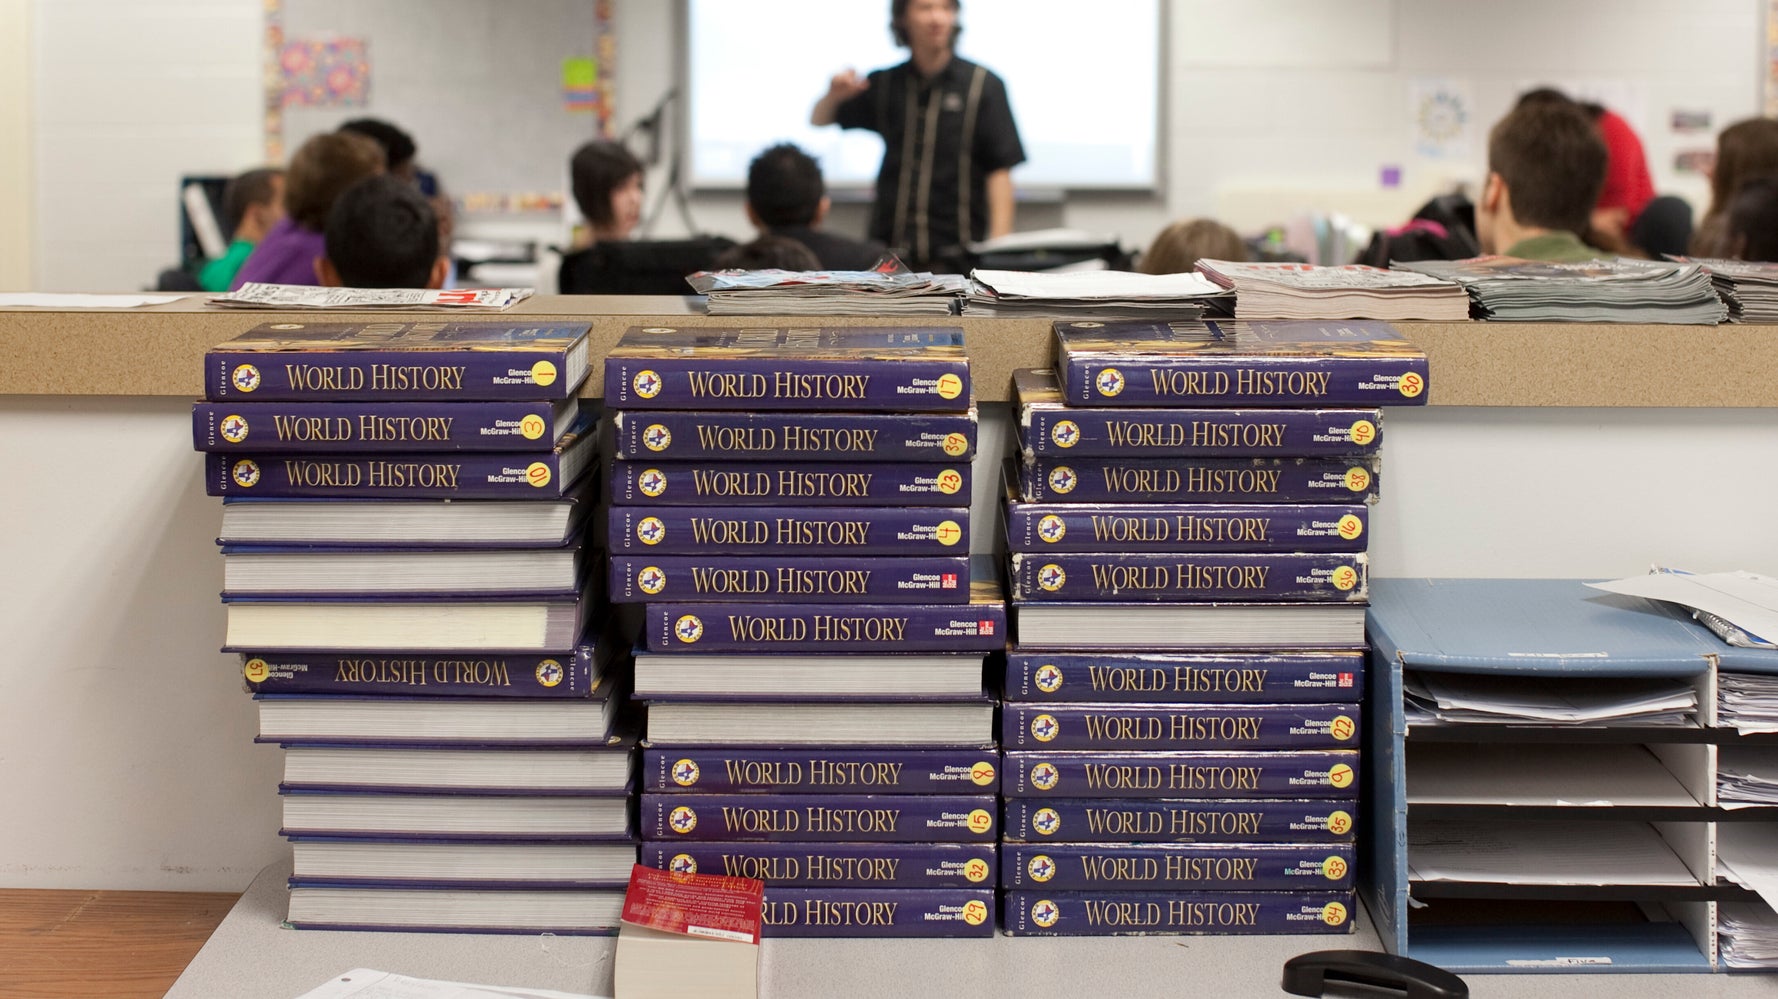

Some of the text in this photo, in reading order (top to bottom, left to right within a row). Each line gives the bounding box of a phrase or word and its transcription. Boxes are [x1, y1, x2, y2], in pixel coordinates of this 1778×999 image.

[286, 365, 363, 390] WORLD
[371, 366, 465, 390] HISTORY
[508, 369, 532, 377] Glenco
[1151, 370, 1229, 394] WORLD
[1237, 370, 1331, 394] HISTORY
[689, 373, 765, 398] WORLD
[773, 373, 870, 398] HISTORY
[940, 379, 958, 394] 17
[1401, 376, 1420, 393] 30
[274, 416, 351, 440] WORLD
[359, 417, 453, 441] HISTORY
[524, 421, 542, 434] 3
[1107, 421, 1184, 446] WORLD
[1192, 421, 1286, 447] HISTORY
[1354, 425, 1372, 443] 40
[698, 426, 775, 450] WORLD
[783, 427, 877, 451] HISTORY
[945, 435, 964, 453] 39
[286, 461, 360, 486] WORLD
[369, 462, 461, 488] HISTORY
[488, 475, 528, 483] McGraw-Hil
[529, 467, 546, 484] 10
[693, 471, 770, 496] WORLD
[778, 472, 872, 496] HISTORY
[940, 474, 960, 491] 23
[1104, 468, 1180, 492] WORLD
[1188, 468, 1281, 493] HISTORY
[1349, 471, 1366, 488] 38
[692, 519, 768, 543] WORLD
[776, 519, 870, 544] HISTORY
[939, 525, 960, 539] 4
[1092, 516, 1168, 541] WORLD
[1176, 516, 1270, 541] HISTORY
[1312, 521, 1339, 529] Glencoe
[1340, 519, 1358, 535] 16
[692, 568, 768, 593] WORLD
[776, 568, 870, 593] HISTORY
[1092, 565, 1168, 590] WORLD
[1176, 565, 1269, 590] HISTORY
[1296, 576, 1333, 584] McGraw-H
[1337, 570, 1354, 588] 36
[729, 616, 805, 640] WORLD
[814, 617, 907, 641] HISTORY
[935, 628, 977, 636] McGraw-Hill
[249, 661, 264, 677] 37
[265, 664, 308, 672] McGraw-Hil
[335, 660, 425, 685] HISTORY
[437, 661, 511, 685] WORLD
[1089, 666, 1166, 691] WORLD
[1174, 667, 1267, 692] HISTORY
[1085, 715, 1161, 739] WORLD
[1169, 715, 1262, 740] HISTORY
[1334, 720, 1352, 737] 22
[725, 760, 801, 784] WORLD
[809, 760, 902, 784] HISTORY
[972, 767, 995, 780] 8
[1085, 764, 1161, 789] WORLD
[1169, 765, 1262, 789] HISTORY
[1332, 769, 1351, 782] 9
[722, 807, 798, 832] WORLD
[807, 808, 899, 832] HISTORY
[971, 814, 990, 830] 15
[1086, 809, 1162, 834] WORLD
[1170, 810, 1263, 834] HISTORY
[1331, 817, 1346, 833] 35
[723, 855, 798, 880] WORLD
[807, 855, 899, 880] HISTORY
[968, 864, 984, 879] 32
[1081, 856, 1157, 881] WORLD
[1165, 856, 1258, 881] HISTORY
[1328, 861, 1345, 877] 33
[760, 900, 897, 925] RLD HISTORY
[965, 901, 984, 922] 29
[1085, 900, 1160, 925] WORLD
[1168, 901, 1260, 926] HISTORY
[1328, 908, 1346, 925] 34
